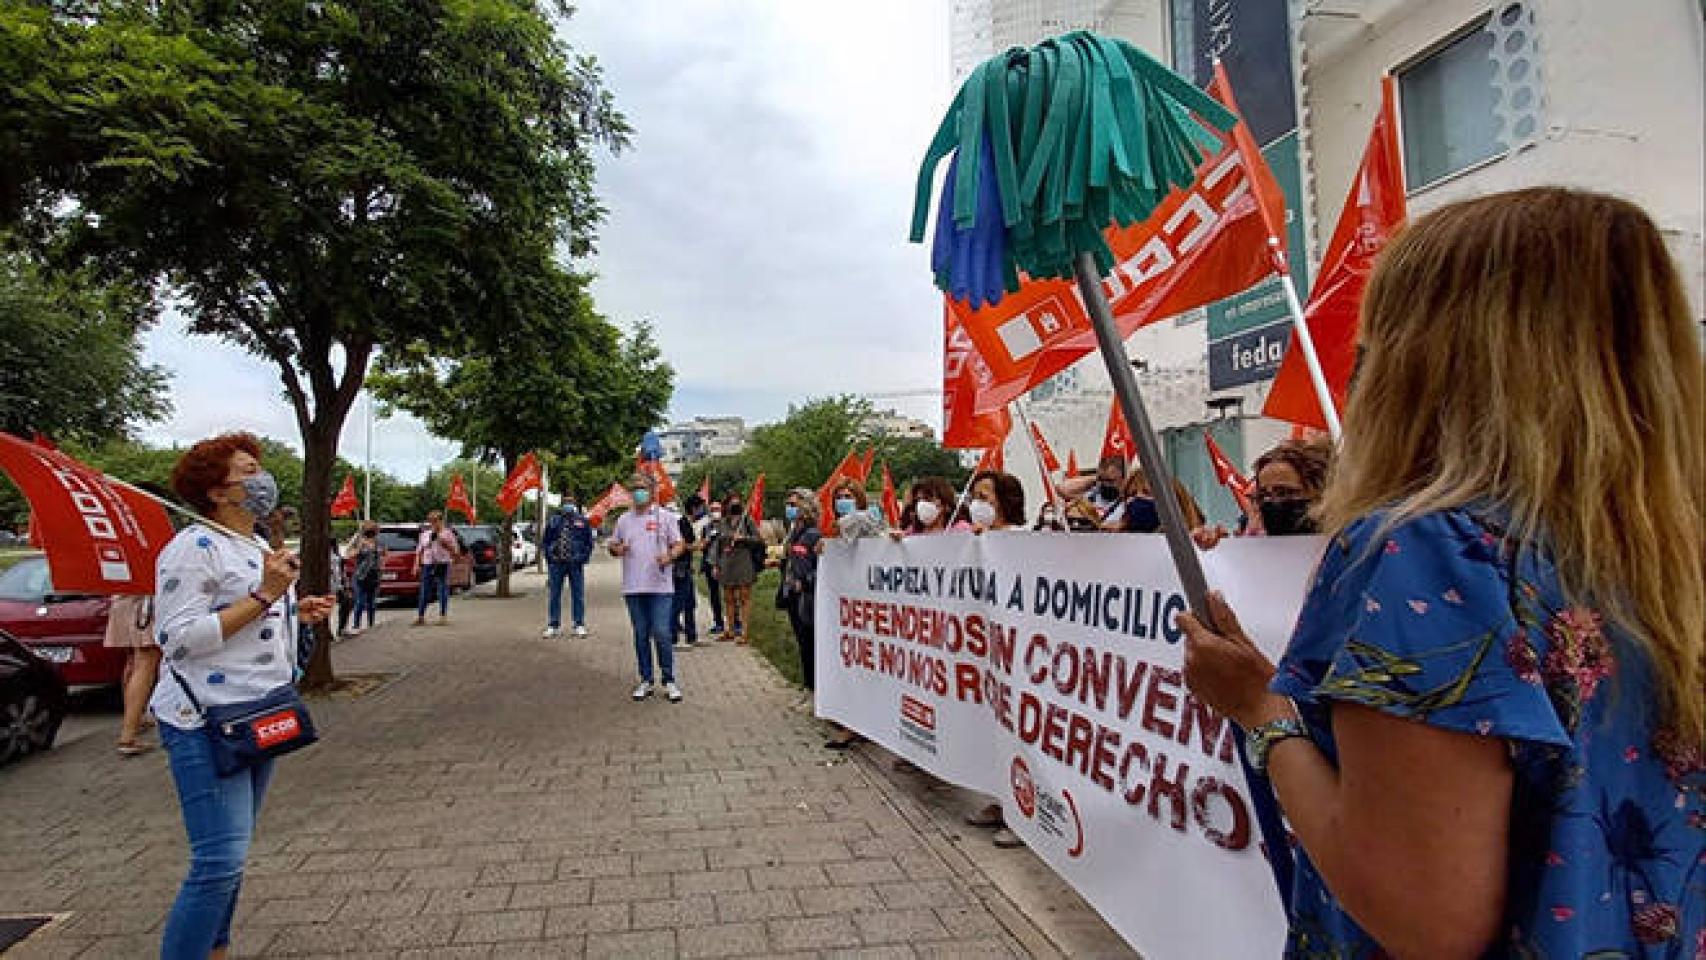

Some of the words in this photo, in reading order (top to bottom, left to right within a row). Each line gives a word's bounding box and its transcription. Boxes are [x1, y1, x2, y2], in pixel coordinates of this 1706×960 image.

[1231, 335, 1284, 371] feda
[839, 596, 988, 658] DEFENDEMOS
[933, 565, 946, 598] Y
[1006, 573, 1025, 613] A
[1033, 575, 1186, 645] DOMICILIO
[257, 716, 298, 739] CCOO
[839, 632, 875, 672] QUE
[878, 640, 905, 680] NO
[908, 648, 947, 697] NOS
[1017, 690, 1268, 857] DERECHO
